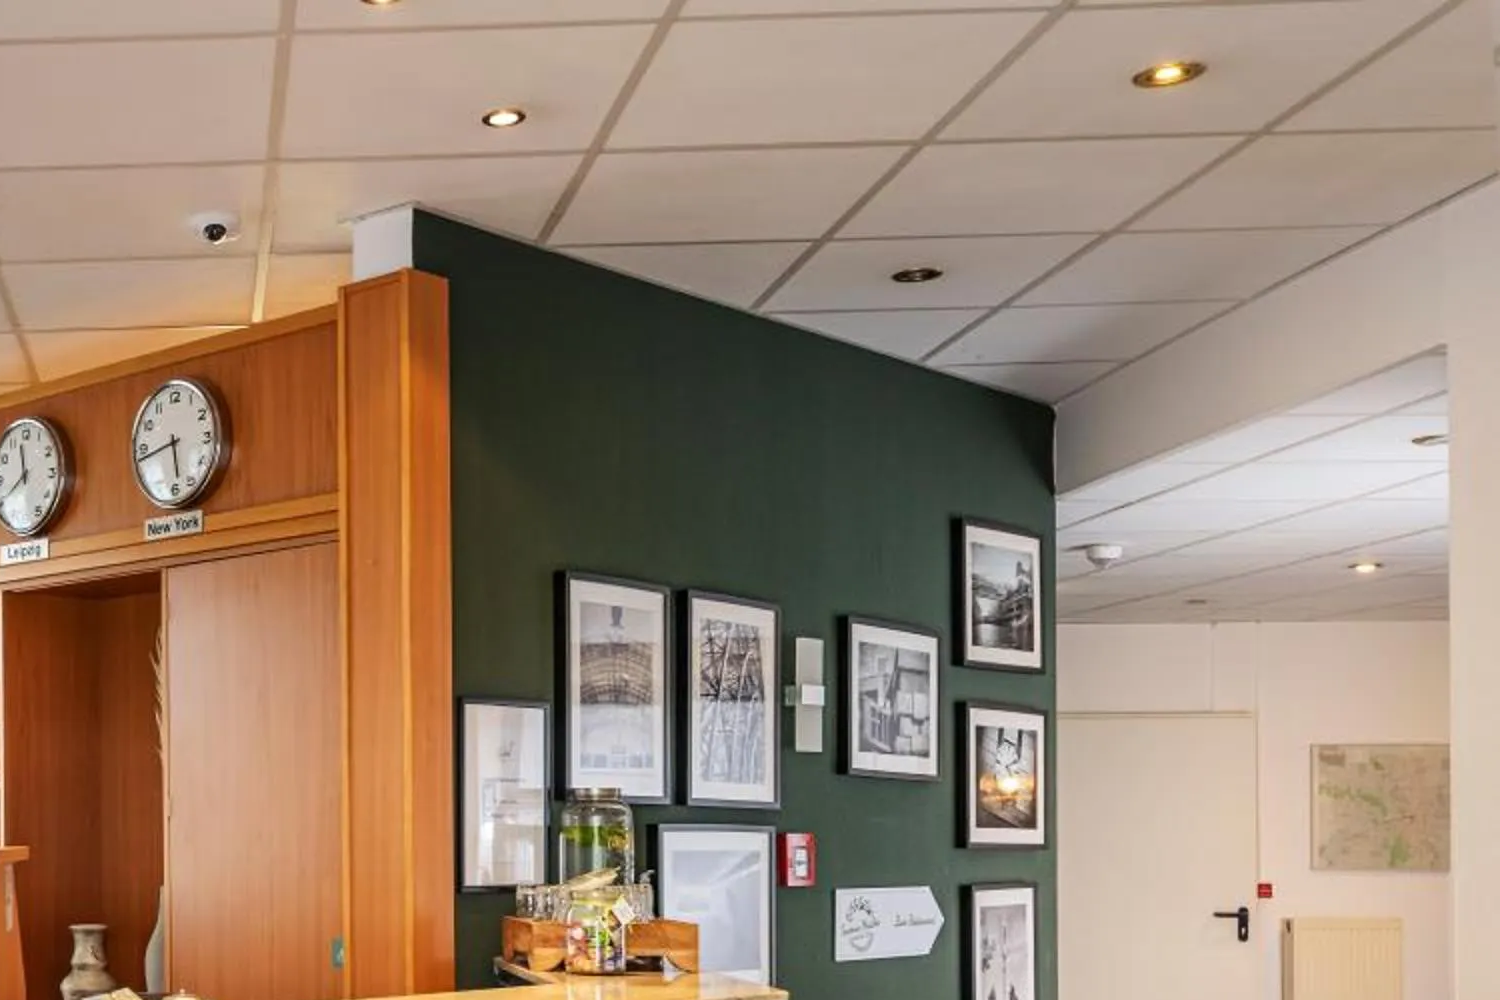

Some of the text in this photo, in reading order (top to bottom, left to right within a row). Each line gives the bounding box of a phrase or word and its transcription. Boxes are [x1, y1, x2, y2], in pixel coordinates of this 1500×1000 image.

[169, 391, 181, 404] 12
[198, 408, 206, 421] 2
[203, 431, 211, 444] 3
[171, 483, 180, 496] 6
[147, 514, 199, 537] New York
